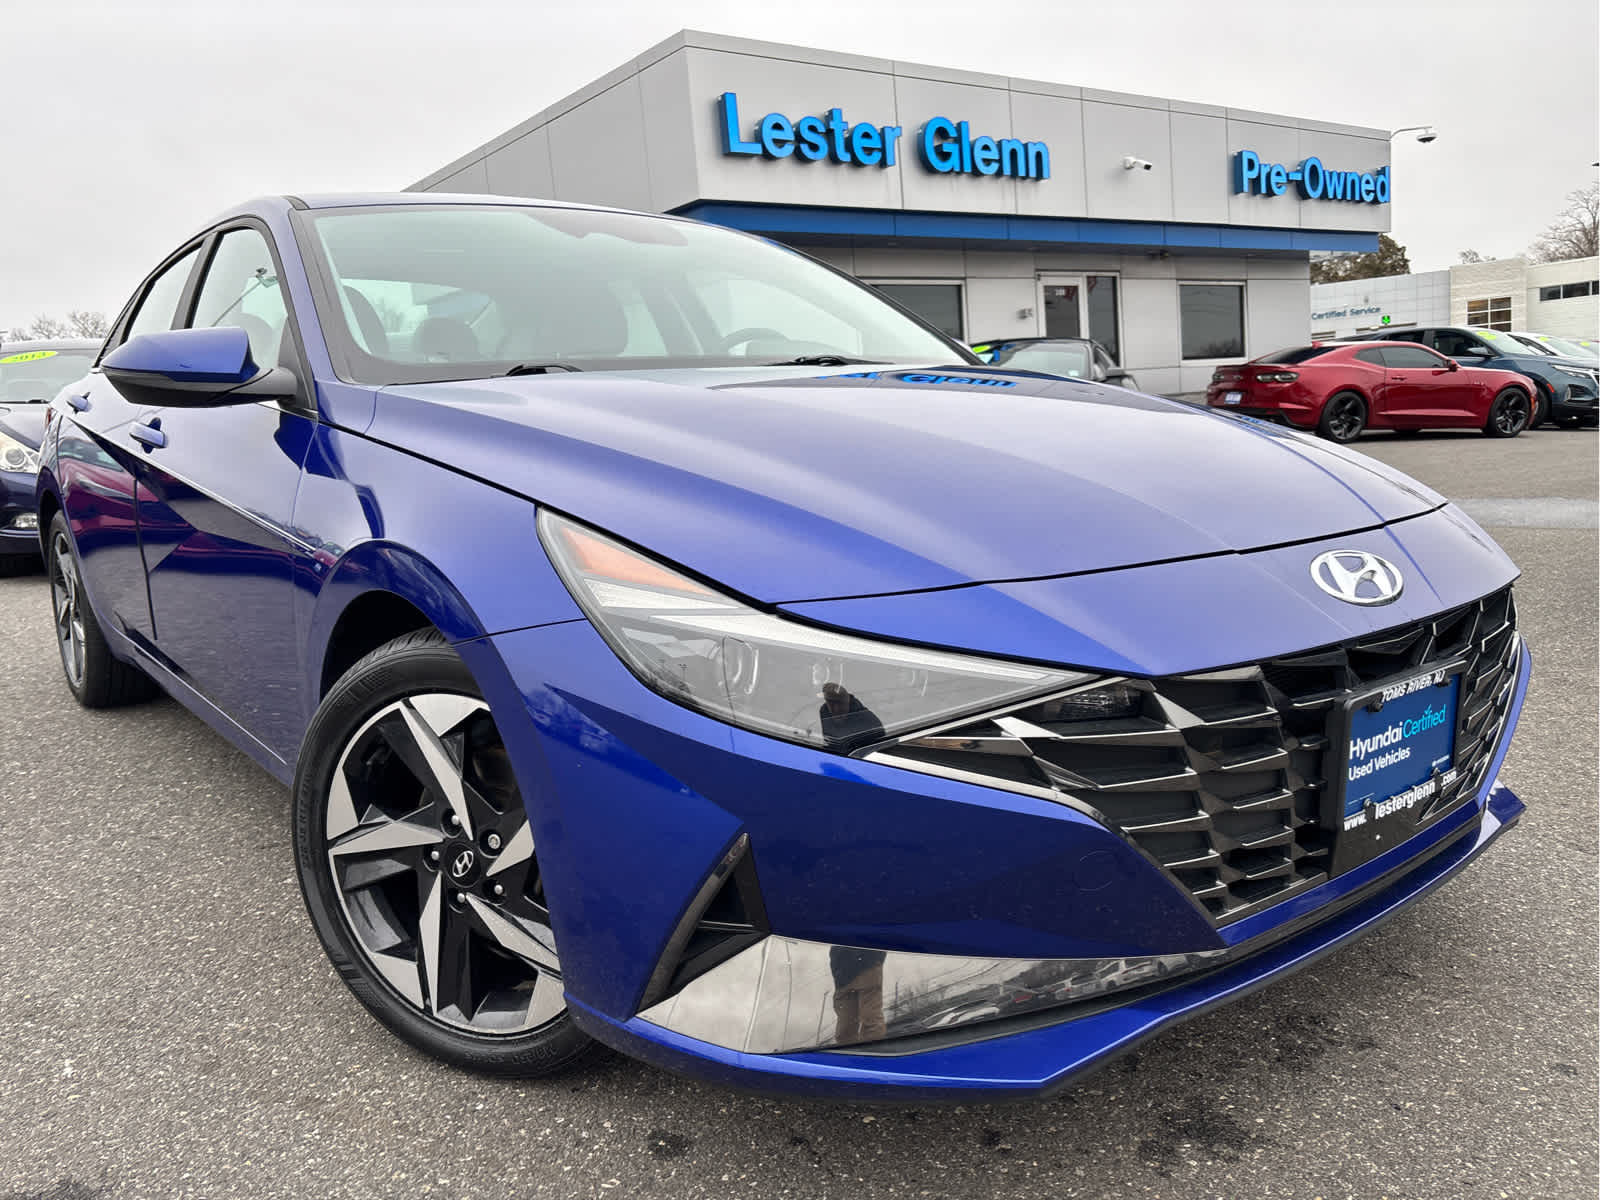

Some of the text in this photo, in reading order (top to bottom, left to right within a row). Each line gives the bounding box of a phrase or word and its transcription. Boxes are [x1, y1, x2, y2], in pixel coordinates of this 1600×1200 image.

[717, 92, 1050, 180] Lester Glenn
[1234, 150, 1391, 204] Pre-Owned
[1311, 306, 1381, 320] Certified Service
[1381, 685, 1406, 703] TOMS
[1348, 758, 1373, 781] Used
[1374, 747, 1411, 770] Vehicles
